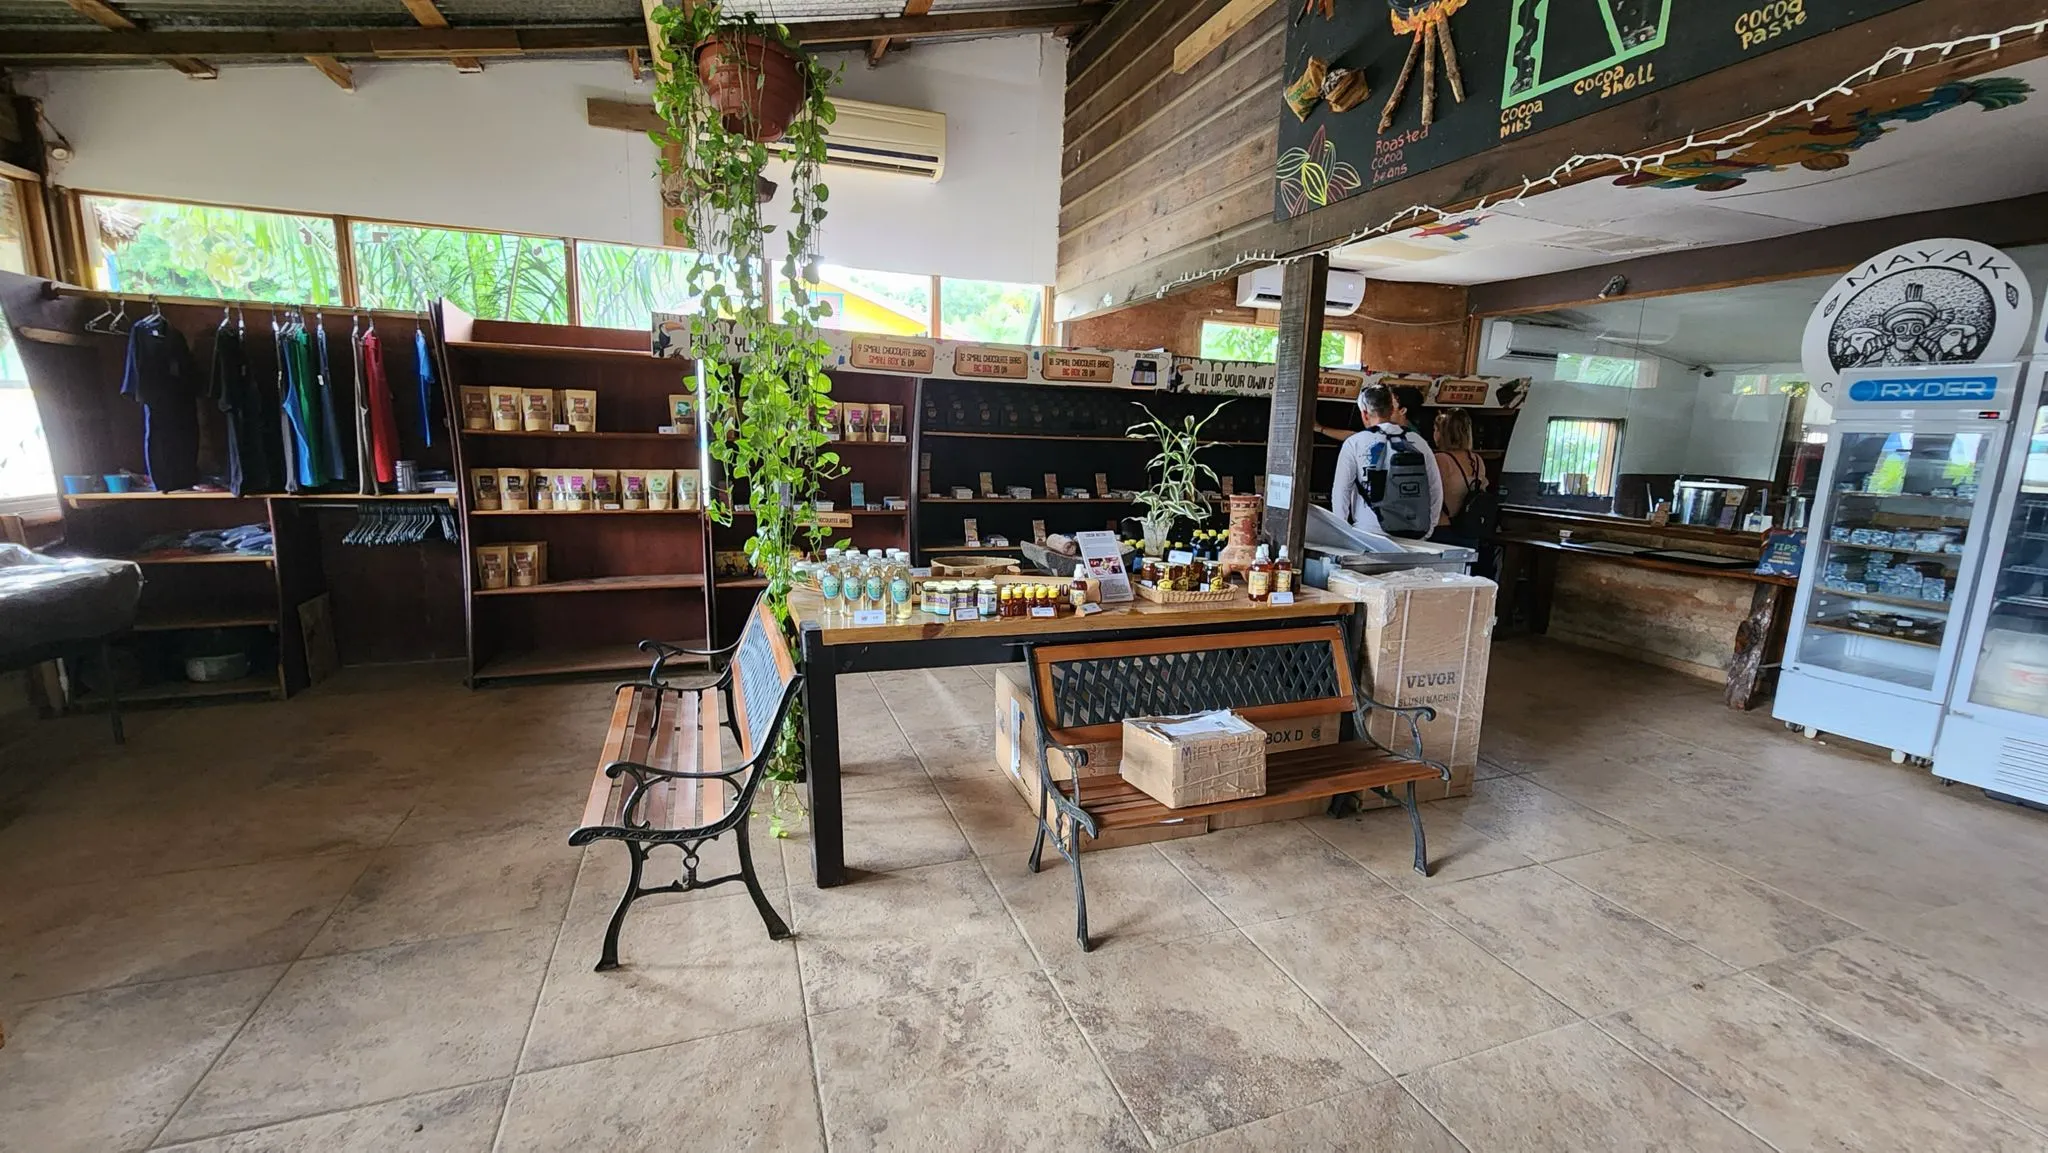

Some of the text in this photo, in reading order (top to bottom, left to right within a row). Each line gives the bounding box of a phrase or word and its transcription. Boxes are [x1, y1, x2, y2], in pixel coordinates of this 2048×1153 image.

[1375, 124, 1430, 154] Roasted
[1372, 163, 1408, 184] beans
[863, 344, 881, 354] SMALL
[882, 346, 911, 357] CHOCOLATE
[912, 348, 927, 358] BARS
[966, 353, 982, 363] SMALL
[982, 354, 1008, 364] CHOCOLATE
[868, 354, 886, 365] SMALL
[887, 357, 899, 366] BOX
[1071, 359, 1097, 368] CHOCOLATE
[1194, 372, 1208, 387] FILL
[1211, 373, 1223, 387] UP
[1224, 373, 1246, 389] YOUR
[1247, 374, 1267, 390] OWN
[1880, 380, 1987, 398] RYDER
[1773, 542, 1798, 553] TIPS
[1406, 671, 1456, 689] VEVOR
[1398, 696, 1425, 707] SLUSH
[1265, 729, 1304, 745] BOX D
